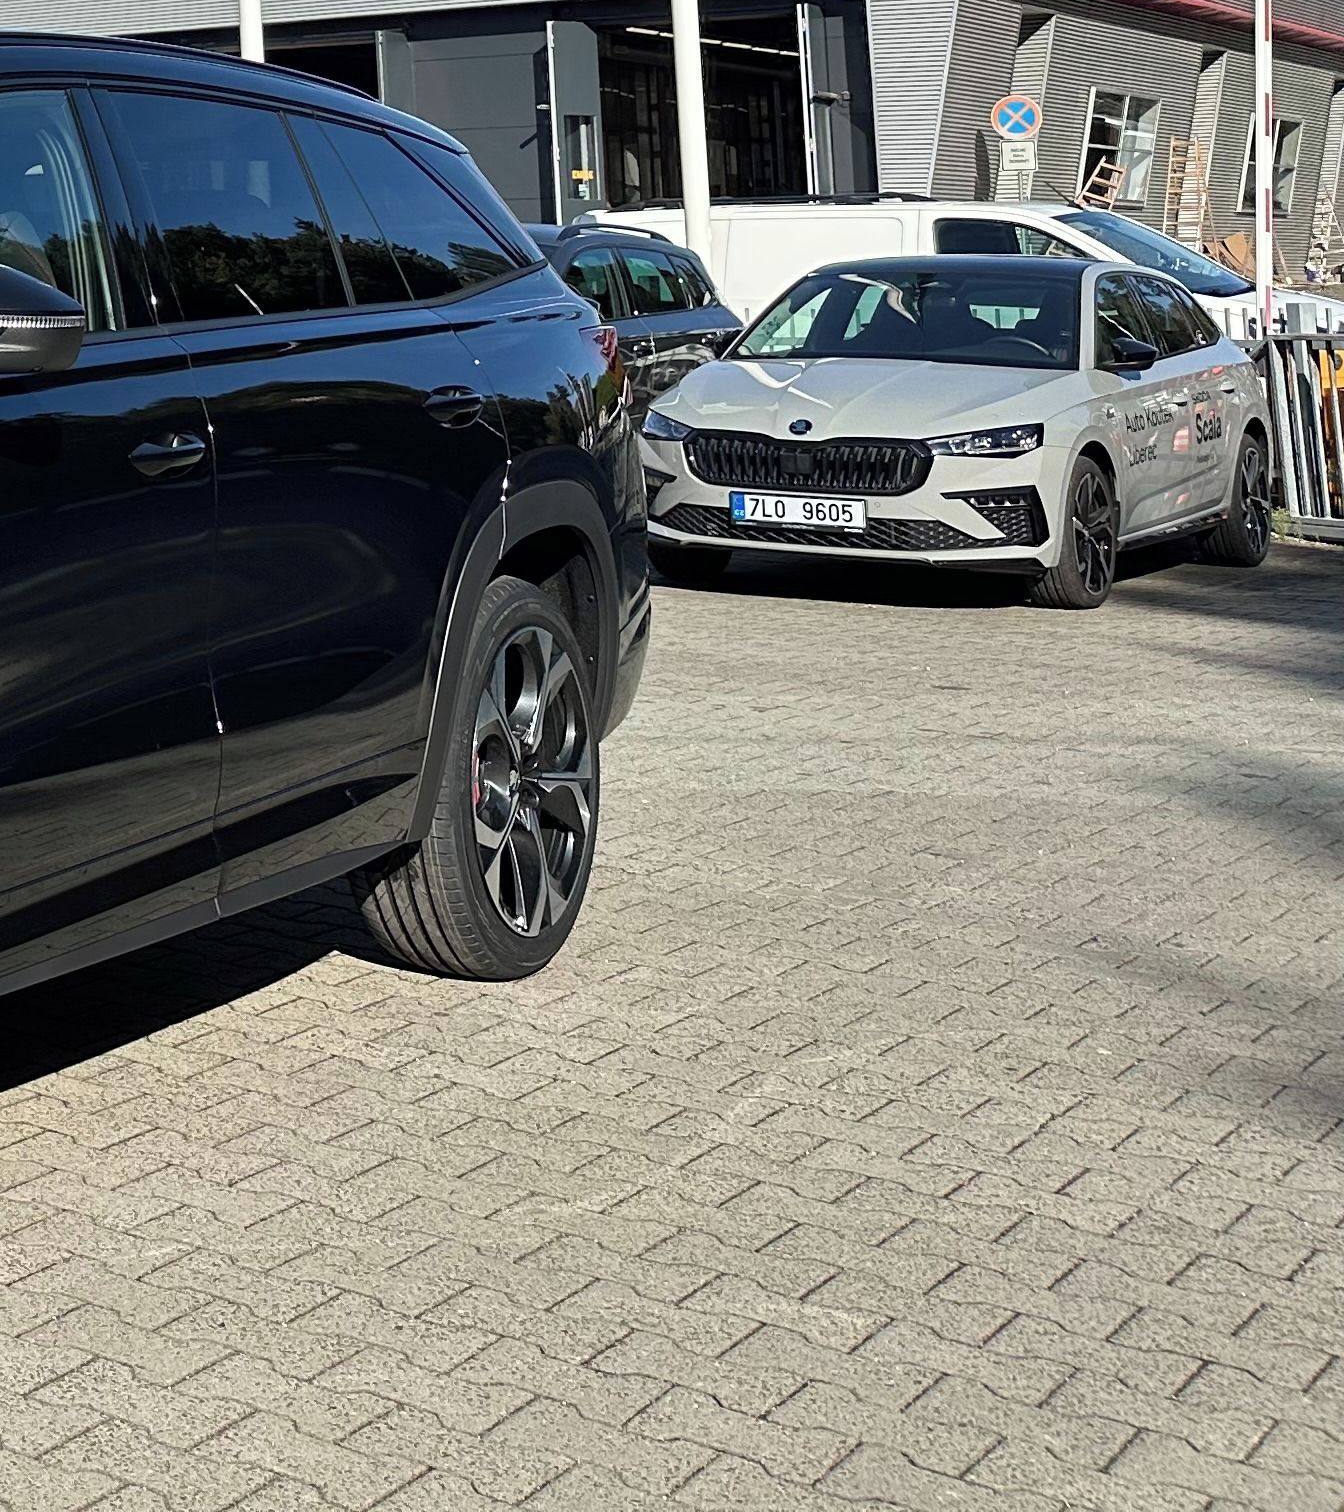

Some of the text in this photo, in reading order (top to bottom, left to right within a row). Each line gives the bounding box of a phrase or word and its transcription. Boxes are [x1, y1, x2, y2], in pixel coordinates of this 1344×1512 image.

[1124, 412, 1146, 434] Auto
[1195, 409, 1222, 445] Scala
[802, 501, 853, 523] 9605
